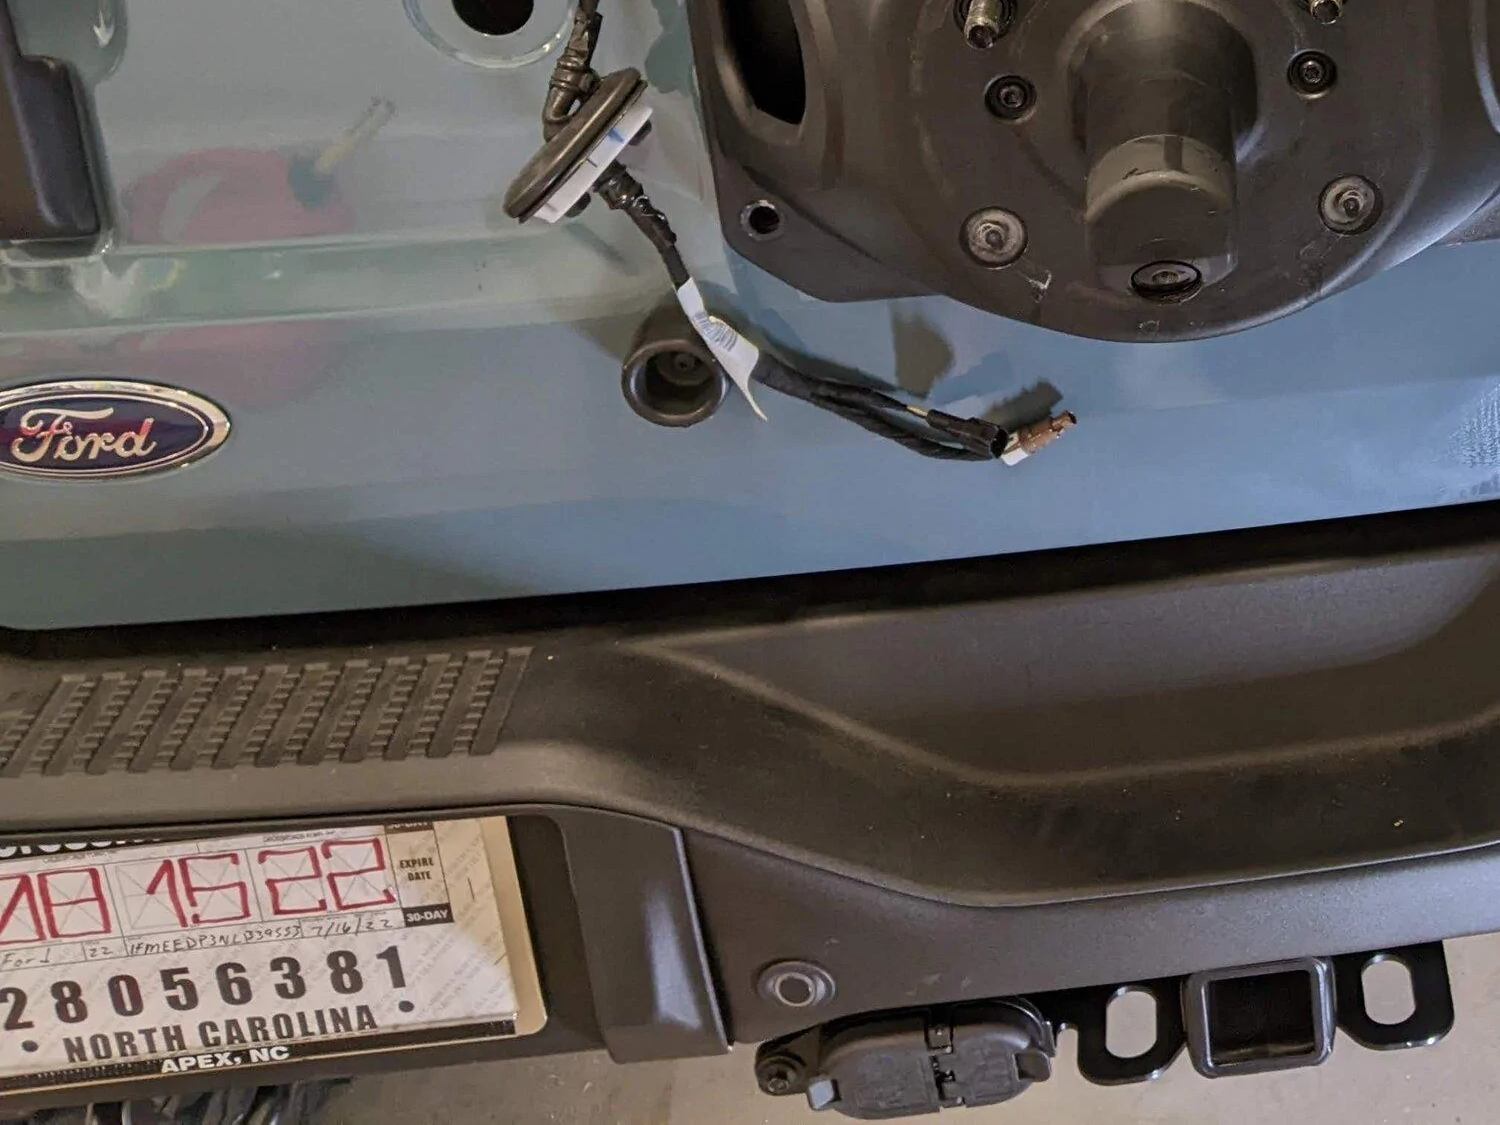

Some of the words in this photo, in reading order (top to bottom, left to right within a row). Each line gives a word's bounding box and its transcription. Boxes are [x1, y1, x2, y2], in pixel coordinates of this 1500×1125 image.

[11, 406, 158, 463] Ford
[146, 852, 251, 928] 15
[258, 837, 396, 915] 22
[400, 857, 435, 869] EXPIRE
[407, 871, 433, 882] DATE
[406, 909, 449, 923] 30-DAY
[0, 945, 408, 1032] 28056381
[63, 1024, 188, 1064] NORTH
[199, 1003, 378, 1049] CAROLINA
[161, 1052, 242, 1074] APEX,
[251, 1045, 291, 1063] NC
